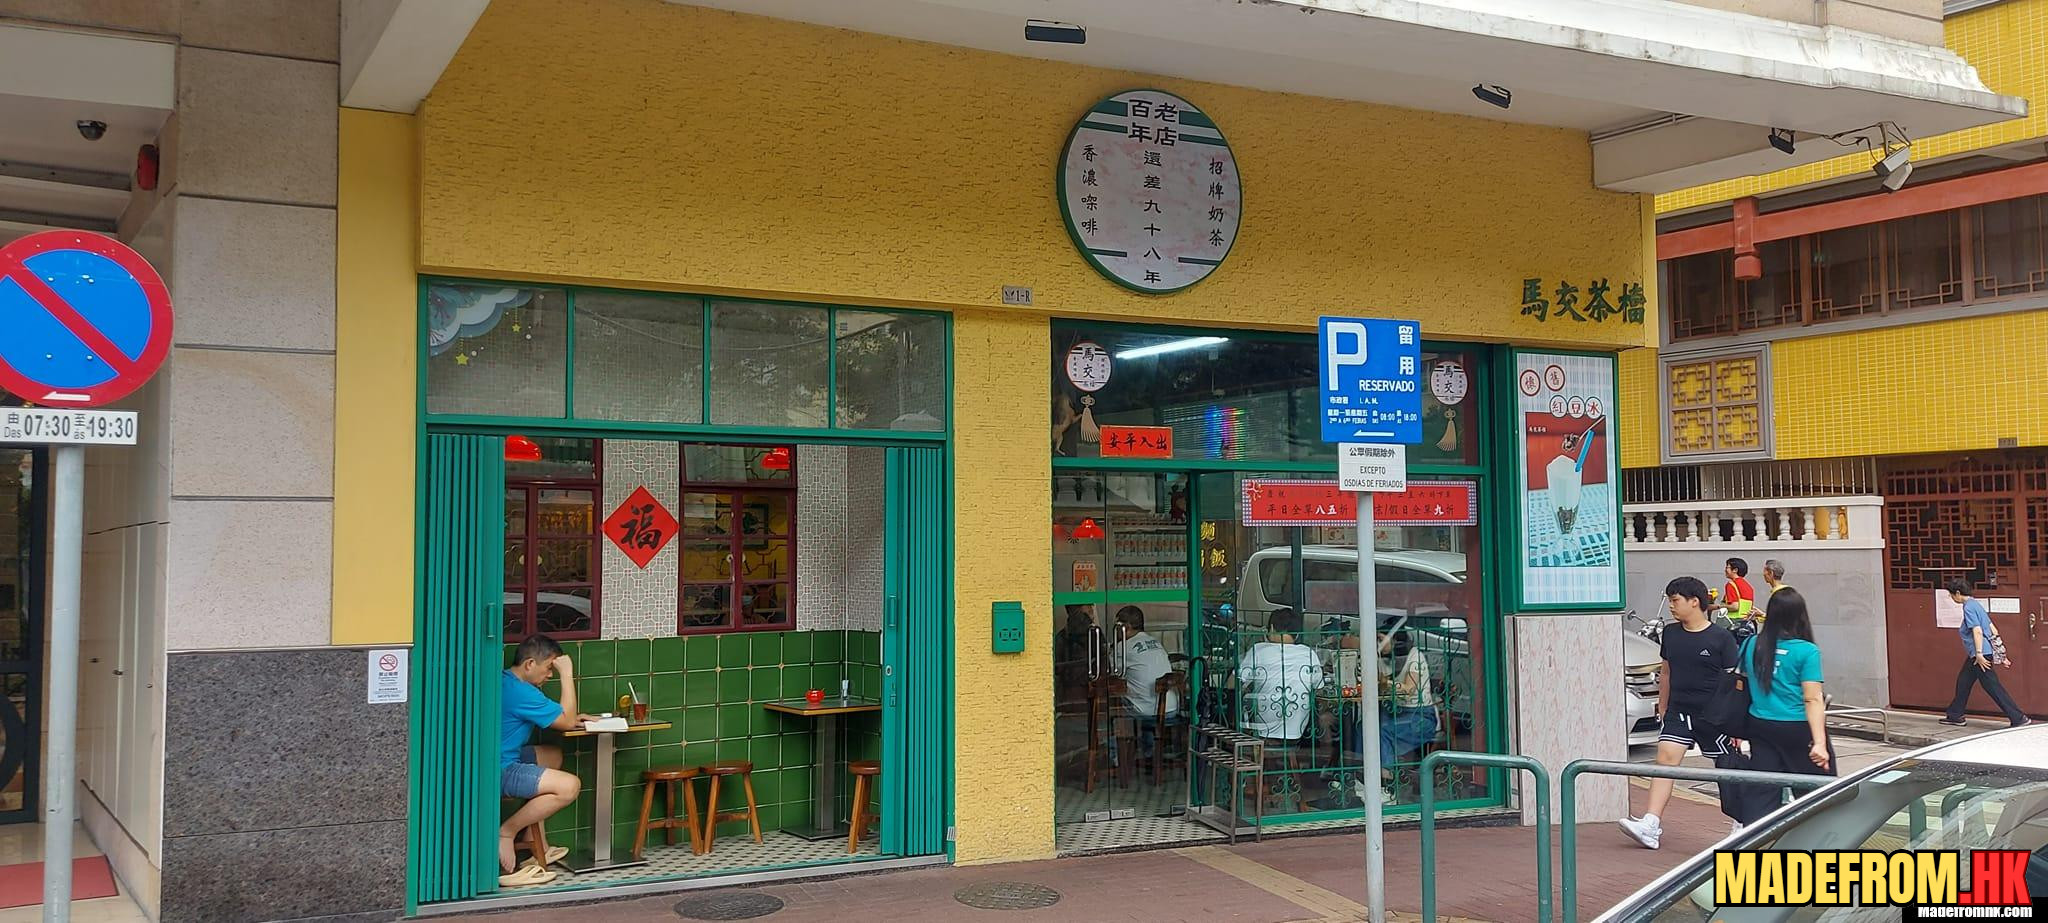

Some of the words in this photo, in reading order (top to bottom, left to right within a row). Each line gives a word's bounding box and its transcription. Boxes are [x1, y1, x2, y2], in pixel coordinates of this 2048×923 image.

[1128, 99, 1153, 143] 百年
[1154, 102, 1178, 147] 老店
[1144, 150, 1162, 283] 還差九十八年
[1208, 157, 1225, 247] 招牌奶茶
[1327, 322, 1368, 391] P
[1398, 325, 1414, 376] 留用
[1359, 380, 1415, 392] RESERVADO
[1551, 401, 1600, 415] 紅豆冰
[4, 426, 22, 439] Das
[8, 412, 19, 424] 由
[24, 414, 71, 436] 07:30
[74, 413, 86, 427] 至
[89, 416, 134, 438] 19:30
[1359, 465, 1386, 475] EXCEPTO
[1366, 479, 1375, 488] DE
[1375, 479, 1404, 489] FERIADOS
[620, 503, 662, 550] 福
